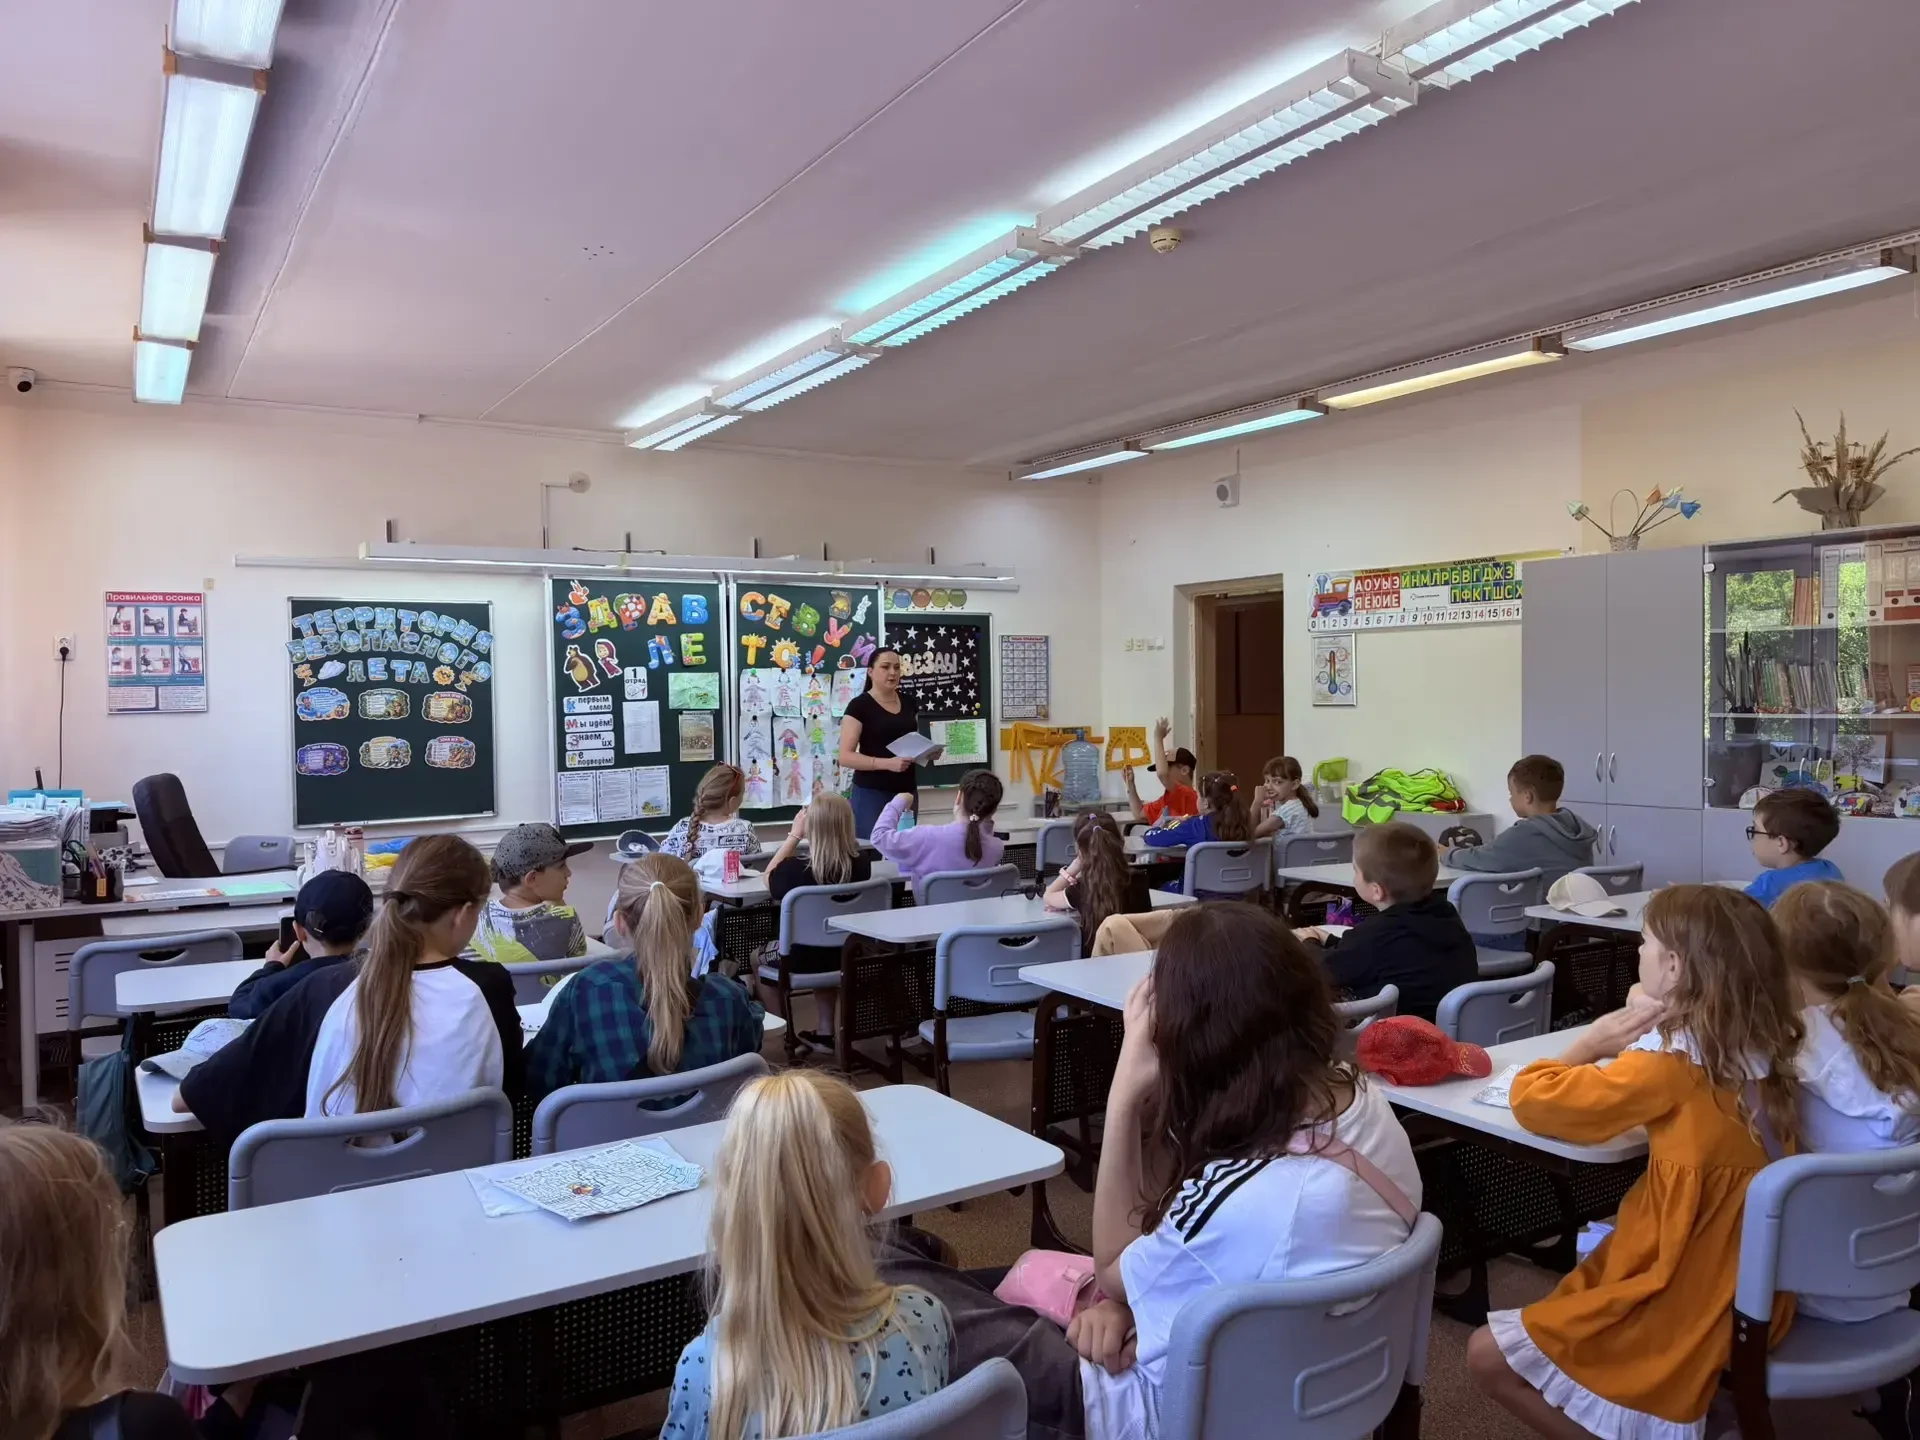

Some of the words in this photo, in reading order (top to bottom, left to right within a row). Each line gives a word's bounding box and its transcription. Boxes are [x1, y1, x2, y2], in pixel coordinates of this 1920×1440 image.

[1453, 557, 1496, 566] СОГЛАСНЫЕ
[106, 593, 163, 601] Правильная
[555, 592, 709, 640] ЗДРАВ
[1365, 617, 1370, 625] 5
[1448, 612, 1458, 620] 12
[1461, 610, 1471, 619] 13
[1474, 610, 1485, 618] 14
[1488, 609, 1498, 618] 15
[1502, 608, 1512, 617] 16
[292, 606, 495, 653] ТЕРРИТОРИЯ
[284, 628, 492, 683] БЕЗОПАСНОГО
[899, 650, 957, 677] ВЕЗДЫ
[347, 657, 430, 683] ЛЕТА
[632, 668, 637, 678] 1
[578, 696, 609, 705] первым
[589, 718, 612, 728] идём!
